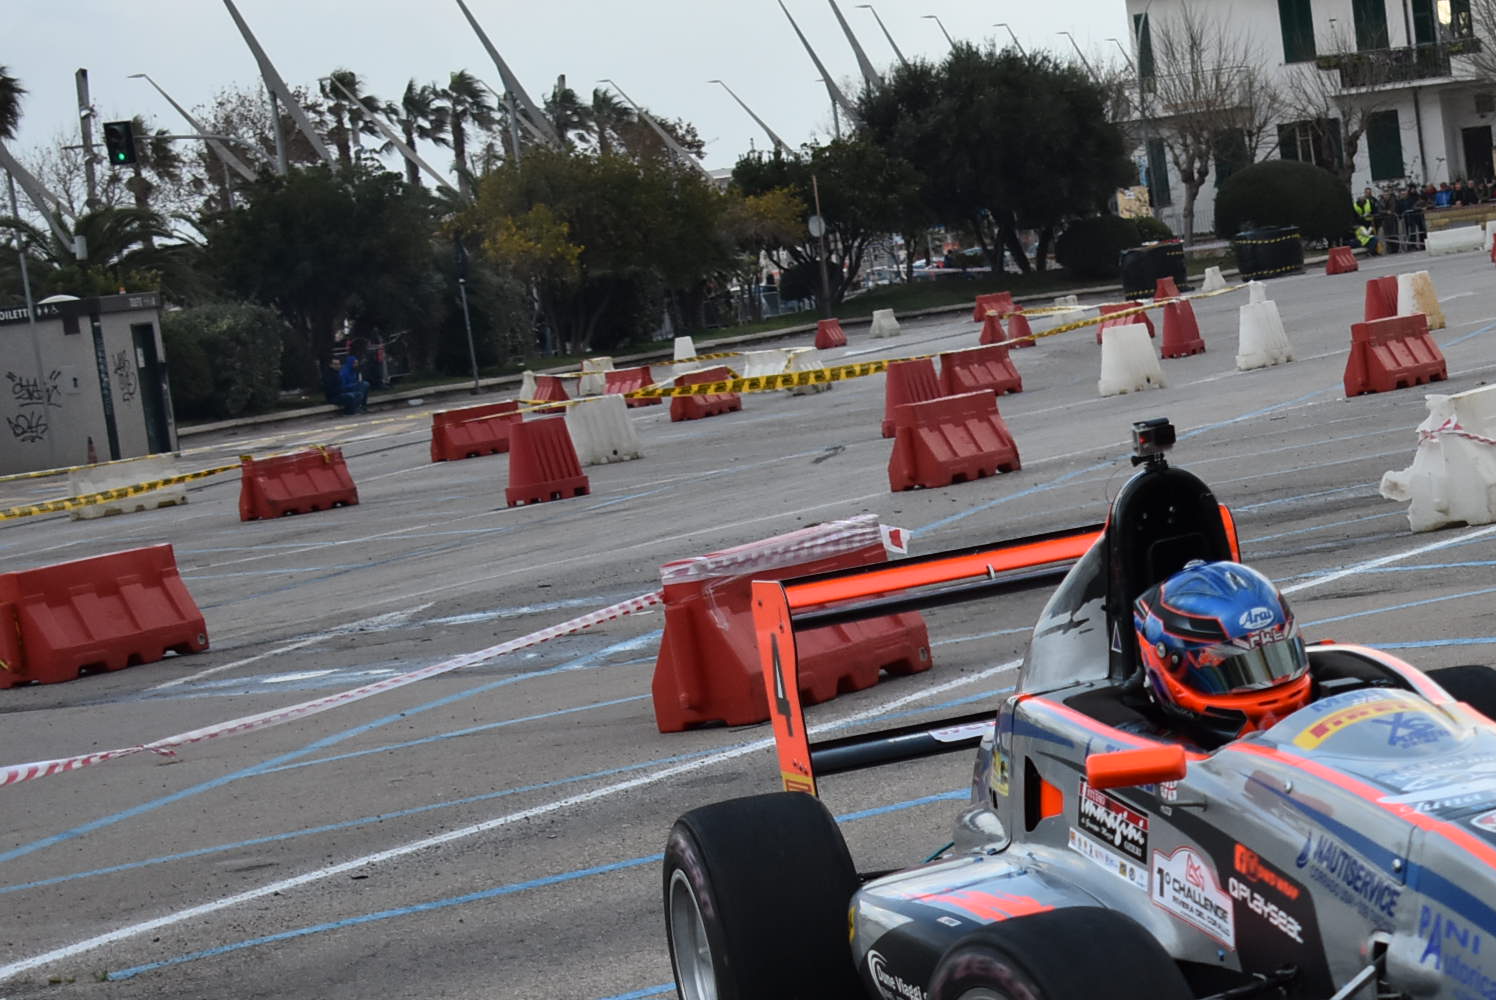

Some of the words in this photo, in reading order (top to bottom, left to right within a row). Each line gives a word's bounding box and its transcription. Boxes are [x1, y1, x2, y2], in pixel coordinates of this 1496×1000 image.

[0, 308, 30, 320] OILETT
[1241, 610, 1271, 626] Arai
[1314, 835, 1400, 917] NAUTISERVICE
[1172, 877, 1229, 924] CHALLENGE
